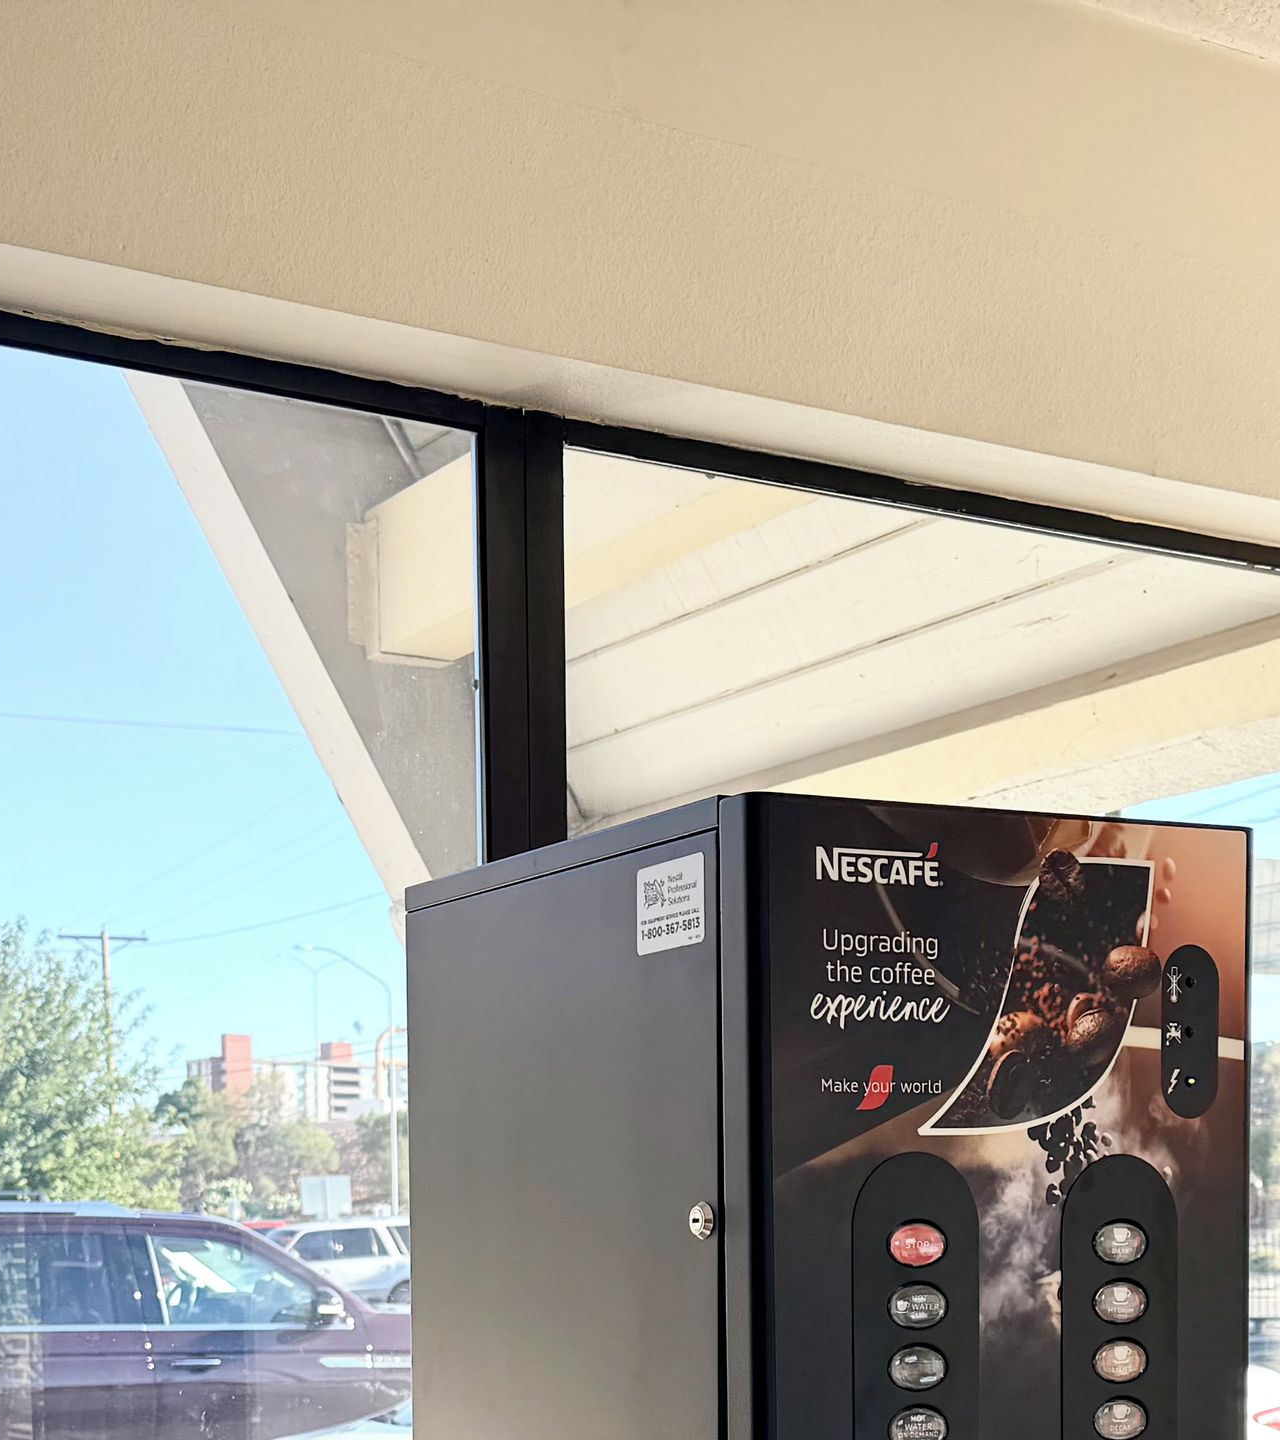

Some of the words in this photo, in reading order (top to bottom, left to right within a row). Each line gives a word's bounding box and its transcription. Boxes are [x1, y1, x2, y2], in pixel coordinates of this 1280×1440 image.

[815, 842, 940, 887] NESCAFÉ
[641, 916, 701, 941] 1-800-367-5813
[822, 928, 939, 959] Upgrading
[826, 961, 864, 984] the
[869, 962, 936, 986] coffee
[810, 990, 950, 1030] experience
[821, 1078, 859, 1095] Make
[863, 1079, 897, 1097] your
[900, 1078, 942, 1095] world
[905, 1240, 930, 1250] STOP
[904, 1422, 933, 1431] WATER
[910, 1414, 927, 1422] HOT
[898, 1431, 908, 1439] ON
[910, 1430, 939, 1438] DEMAND
[1109, 1424, 1131, 1432] DECAF
